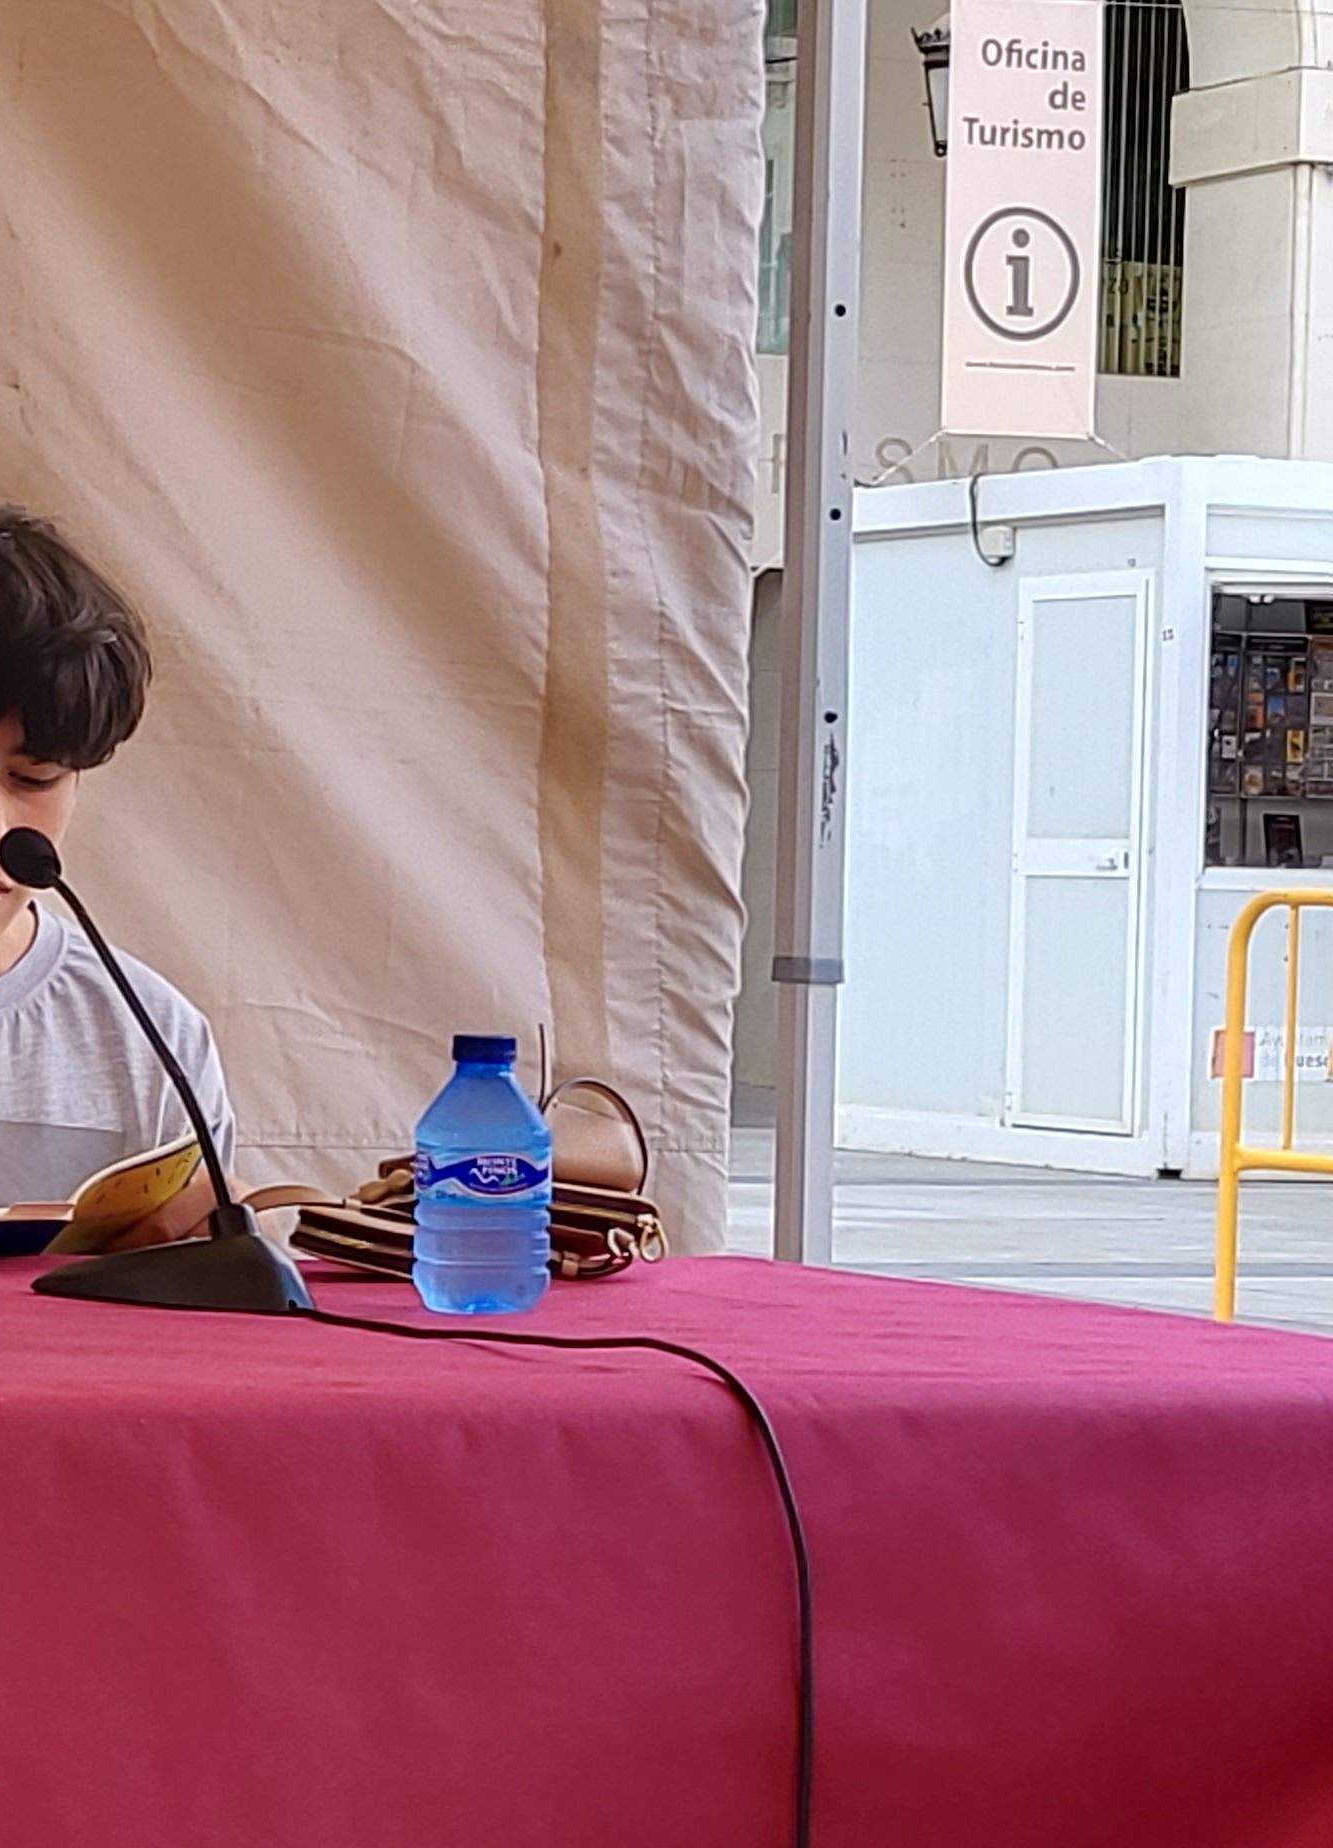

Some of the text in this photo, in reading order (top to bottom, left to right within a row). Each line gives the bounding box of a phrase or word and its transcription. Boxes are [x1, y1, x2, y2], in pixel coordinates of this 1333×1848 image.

[981, 38, 1086, 72] Oficina
[1048, 81, 1086, 111] de
[962, 116, 1086, 151] Turismo
